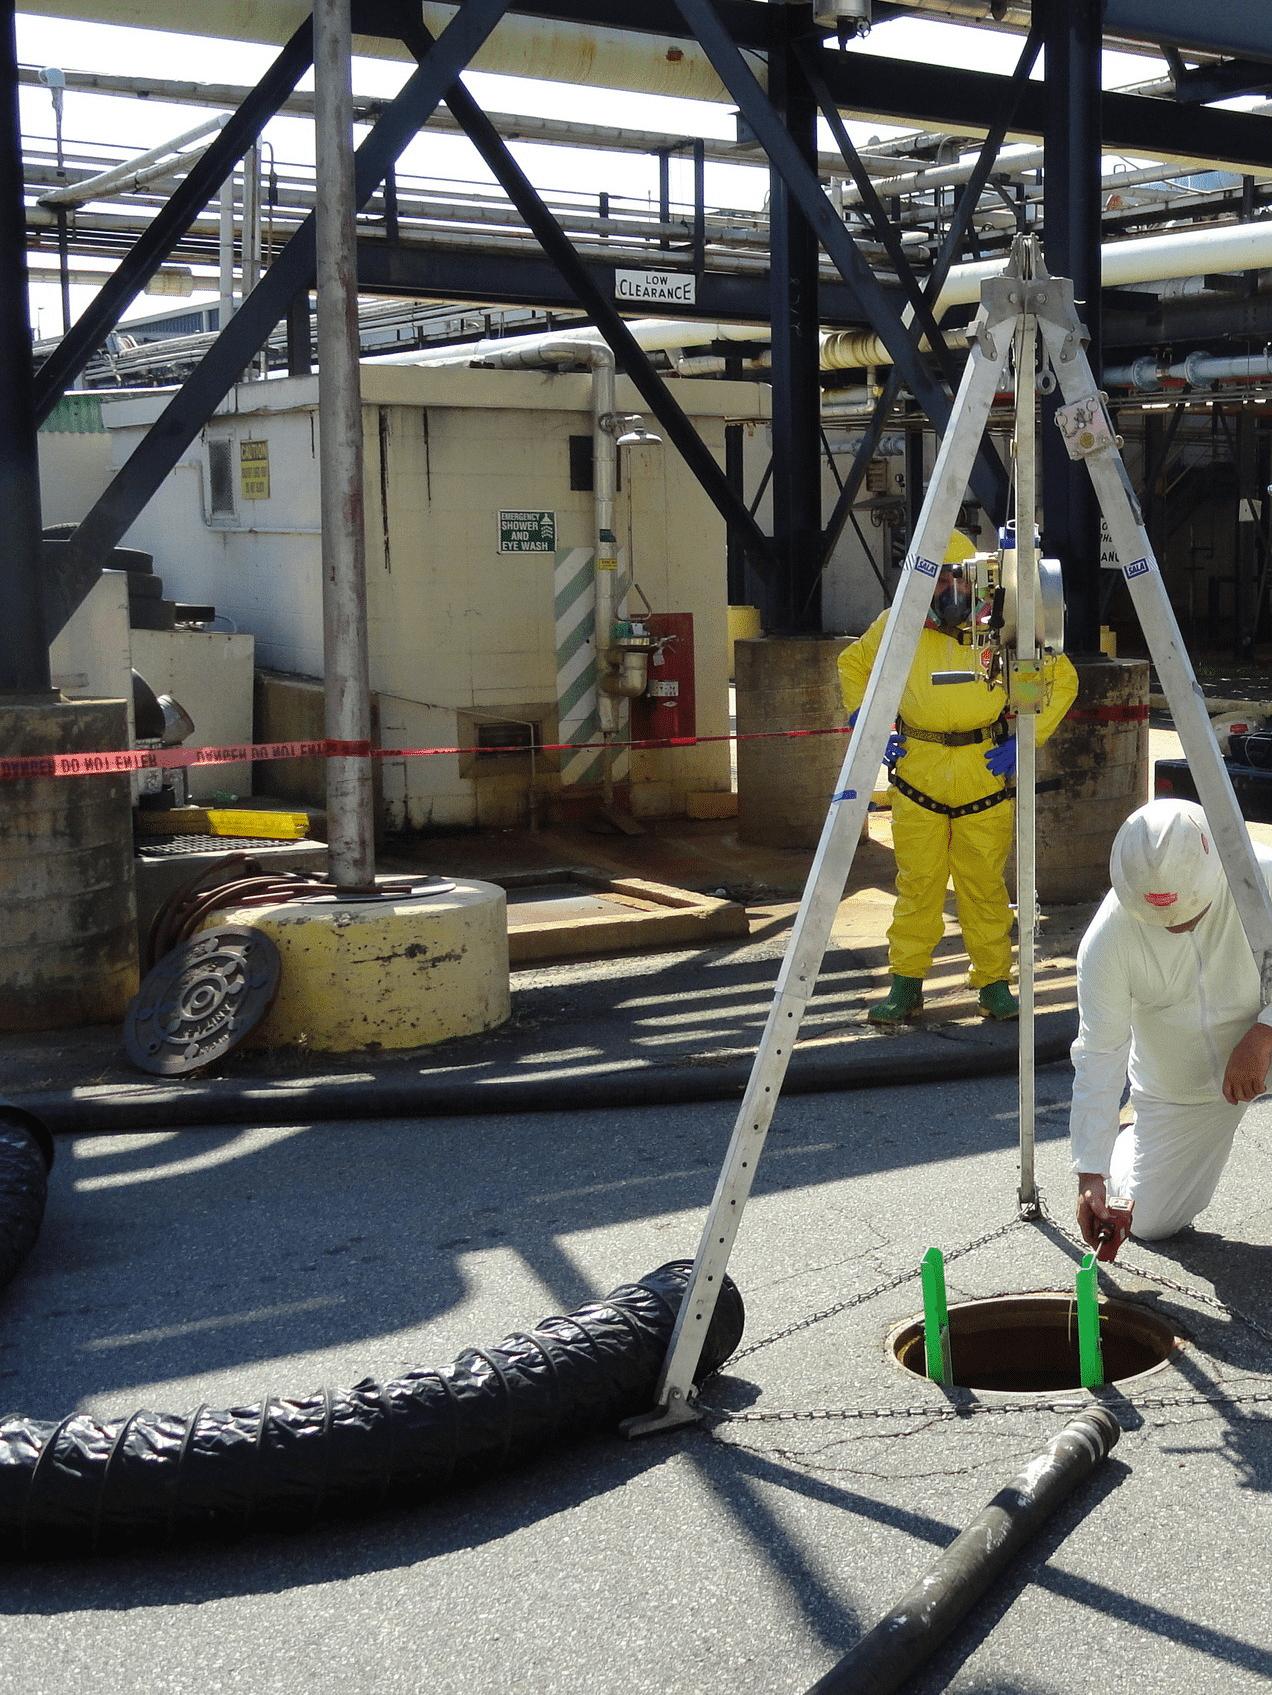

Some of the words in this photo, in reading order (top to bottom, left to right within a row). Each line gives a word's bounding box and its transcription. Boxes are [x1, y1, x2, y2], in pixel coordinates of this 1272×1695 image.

[646, 275, 668, 285] LOW
[620, 279, 691, 300] CLEARANCE
[501, 512, 540, 521] EMERGENCY
[501, 521, 539, 530] SHOWER
[511, 531, 529, 540] AND
[502, 541, 519, 550] EYE
[521, 541, 548, 550] WASH
[917, 560, 935, 574] SALA
[1128, 562, 1145, 575] SALA
